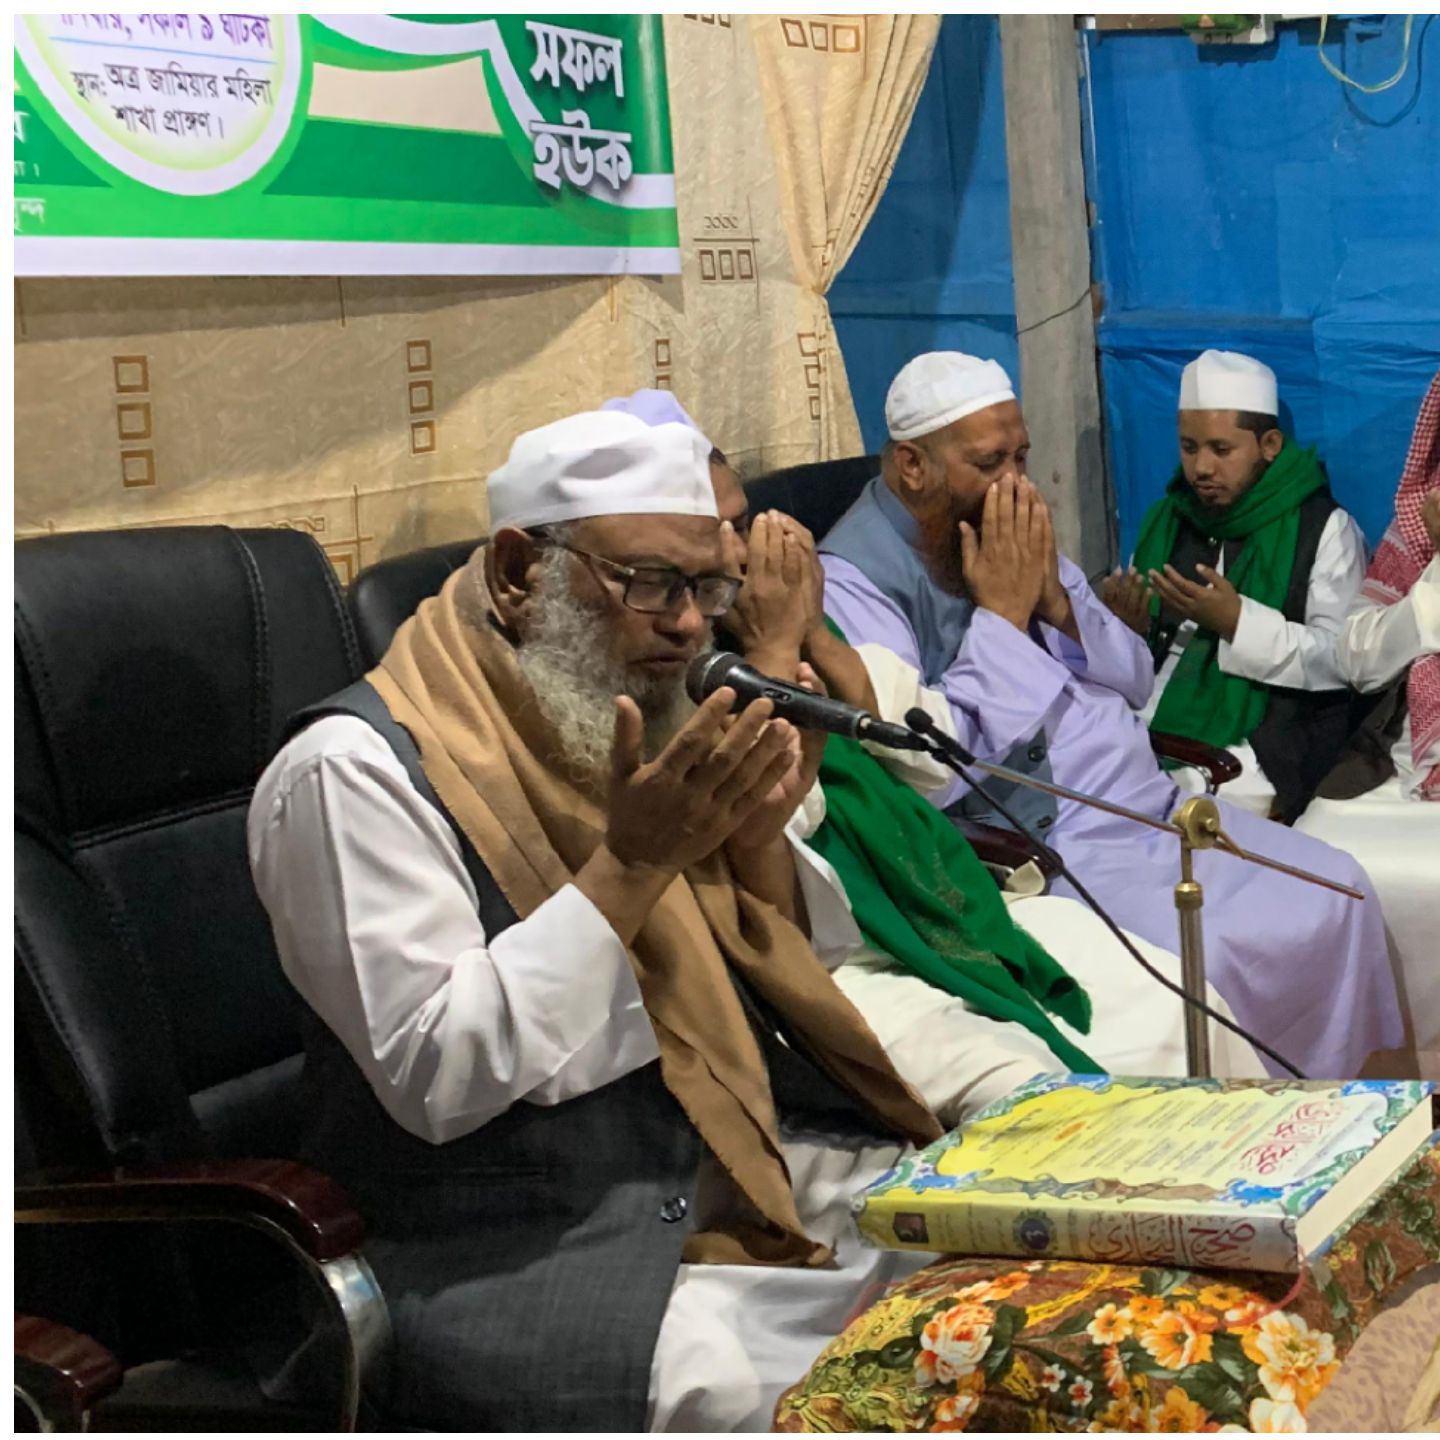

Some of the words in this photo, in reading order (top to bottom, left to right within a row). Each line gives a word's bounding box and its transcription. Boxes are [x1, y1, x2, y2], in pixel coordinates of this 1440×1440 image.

[104, 63, 141, 92] অত্র
[144, 61, 219, 97] জামিয়ার
[224, 67, 273, 105] মহিলা
[525, 20, 624, 98] সফল
[113, 105, 157, 134] শাখা
[530, 109, 633, 190] হউক
